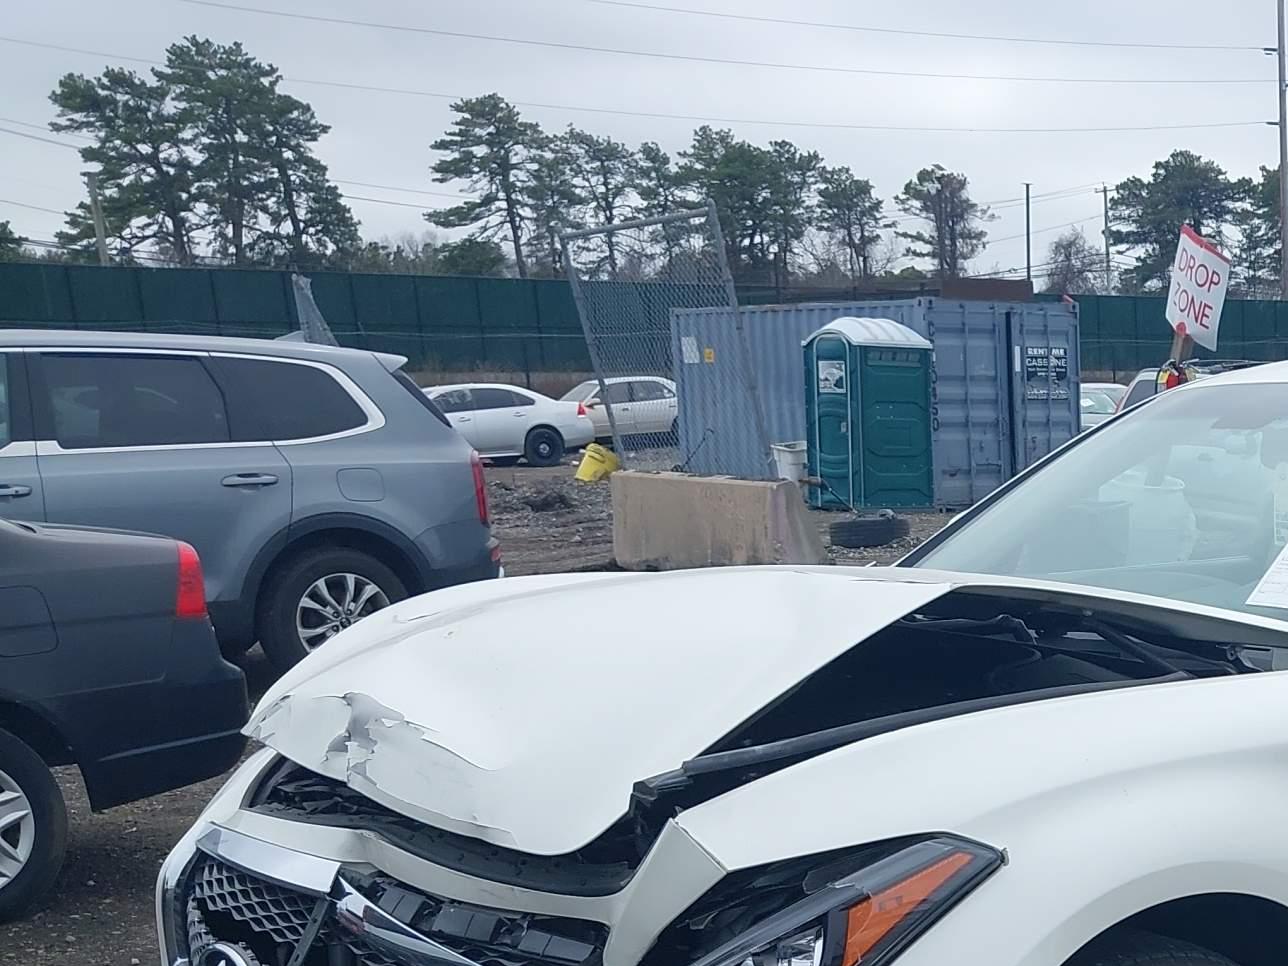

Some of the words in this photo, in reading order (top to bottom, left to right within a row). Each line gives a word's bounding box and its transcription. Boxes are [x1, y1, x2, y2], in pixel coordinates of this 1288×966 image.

[1178, 246, 1221, 293] DROP
[1173, 281, 1213, 330] ZONE
[1027, 347, 1048, 355] RENT
[1051, 348, 1065, 356] ME
